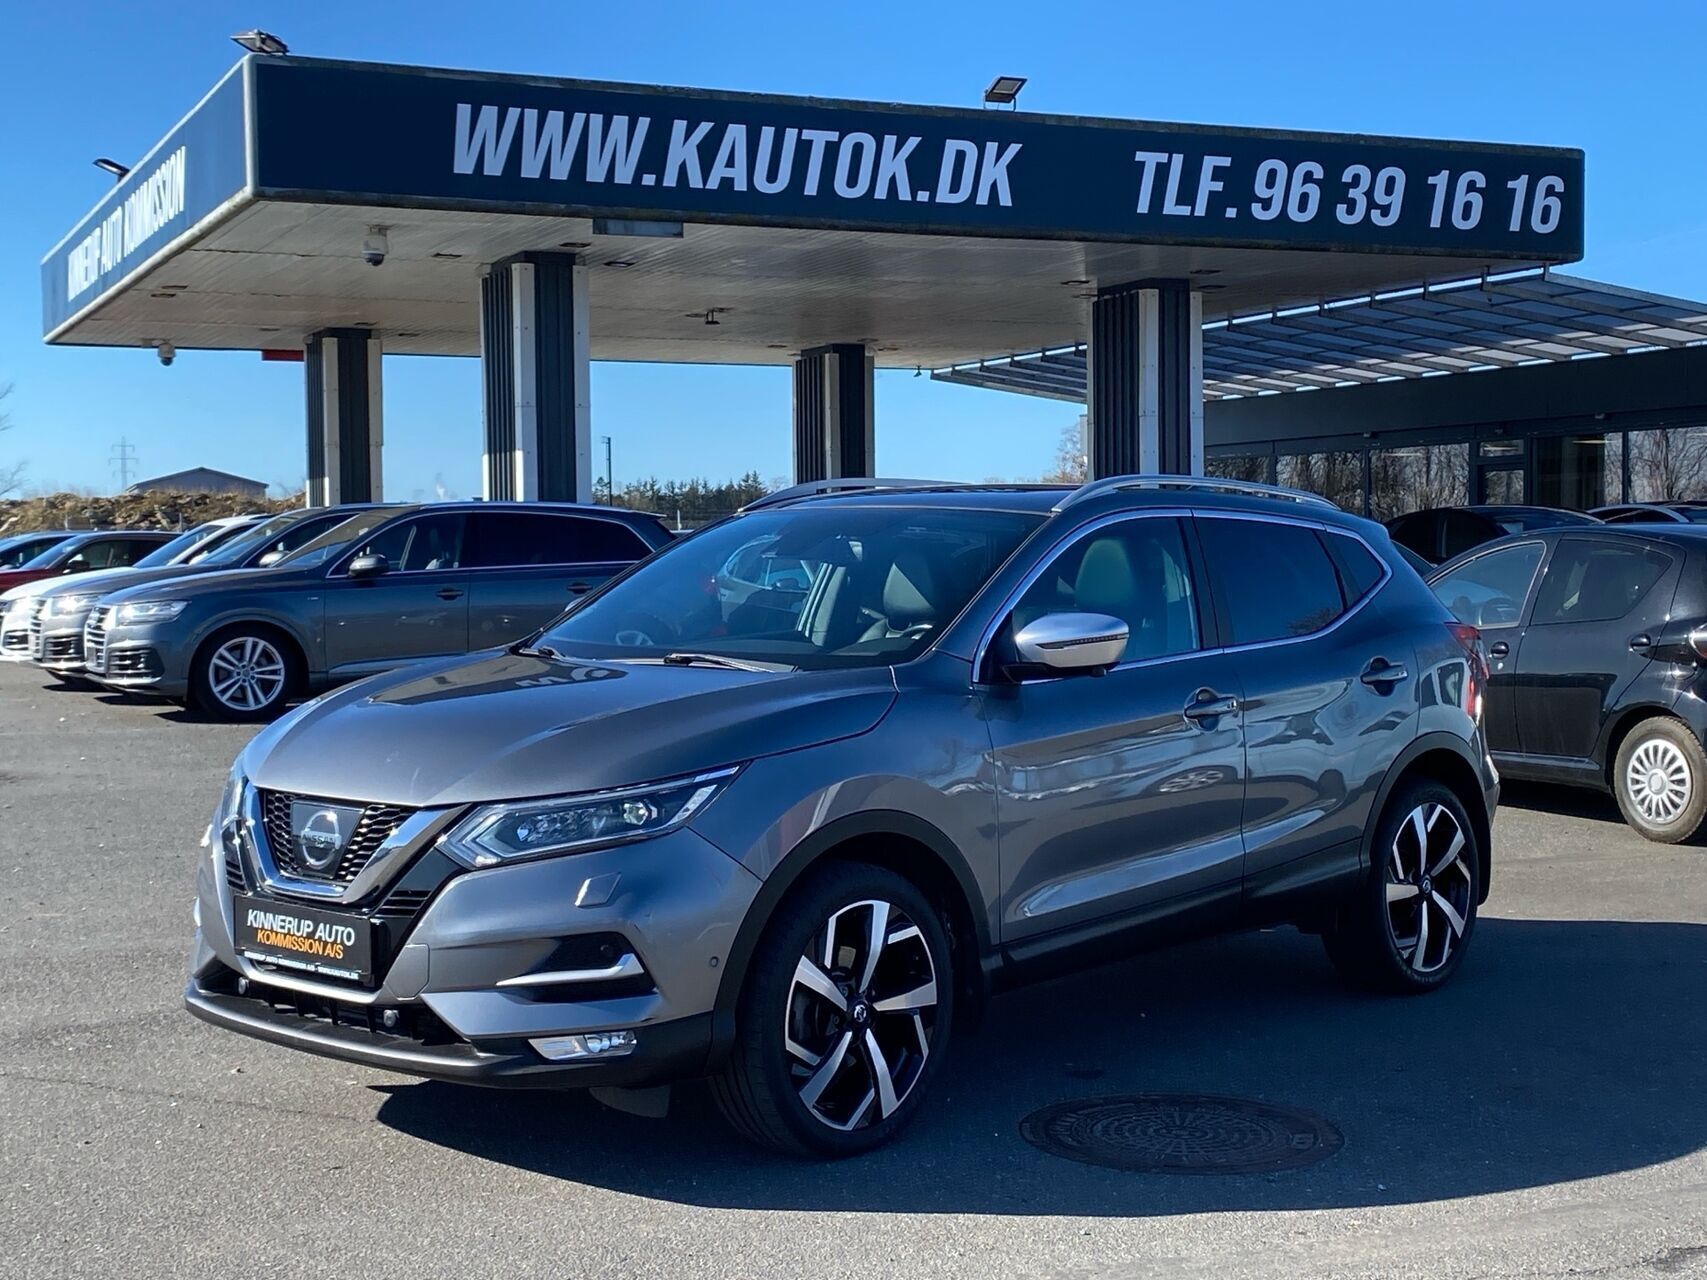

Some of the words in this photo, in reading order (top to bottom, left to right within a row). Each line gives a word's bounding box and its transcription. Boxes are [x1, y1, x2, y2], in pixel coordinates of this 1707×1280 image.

[453, 103, 1023, 206] WWW.KAUTOK.DK
[1134, 151, 1237, 218] TLF.
[1251, 158, 1324, 222] 96
[1335, 164, 1406, 227] 39
[1427, 169, 1486, 230] 16
[1507, 174, 1565, 234] 16
[246, 908, 314, 937] KINNERUP
[314, 922, 355, 946] AUTO
[257, 930, 323, 956] KOMMISSION
[324, 943, 344, 959] A/S
